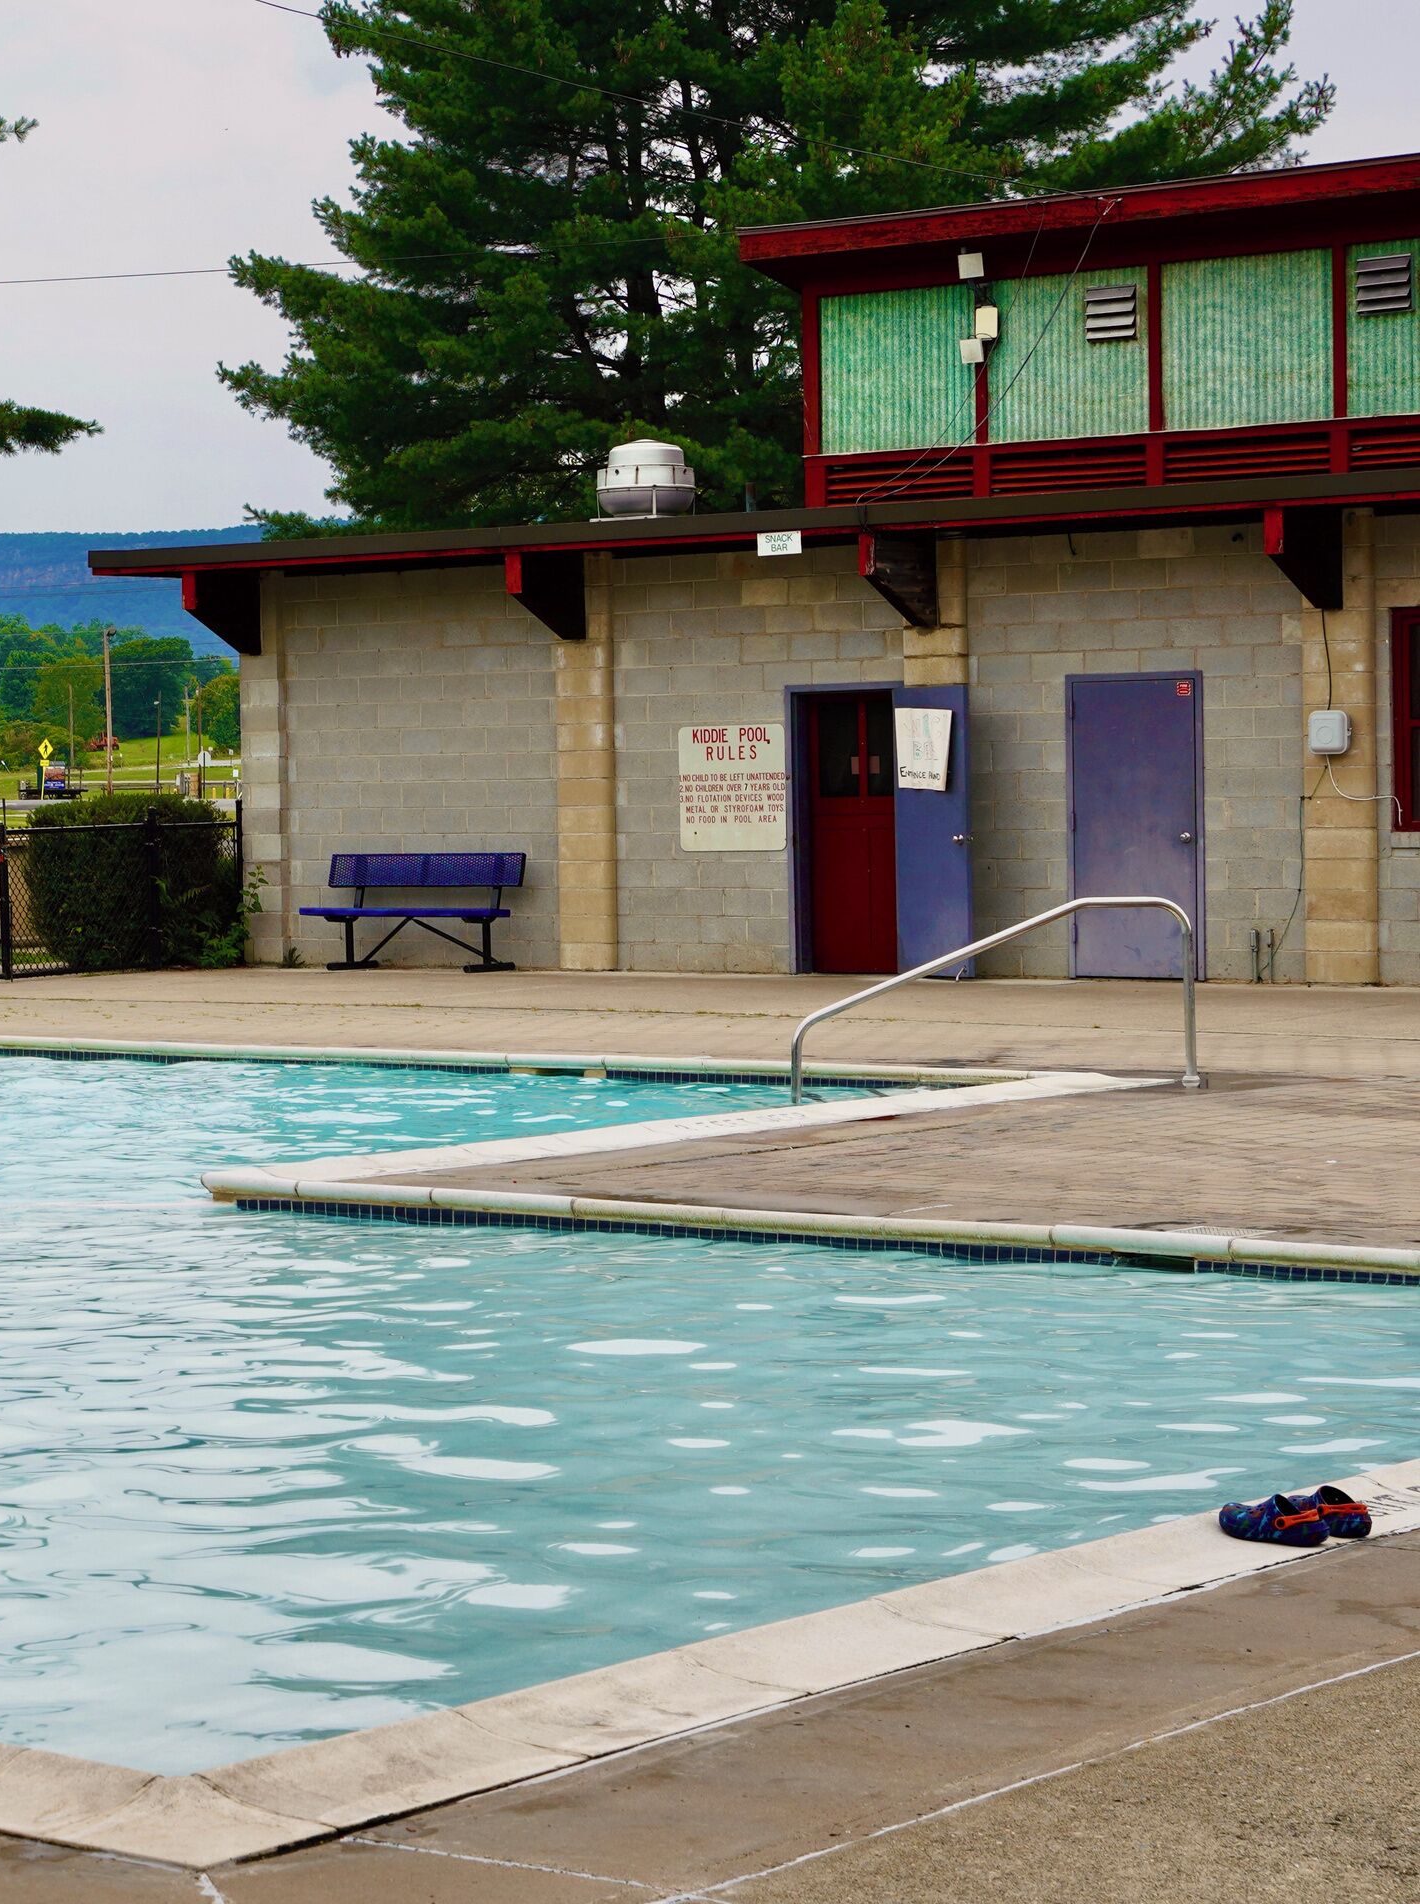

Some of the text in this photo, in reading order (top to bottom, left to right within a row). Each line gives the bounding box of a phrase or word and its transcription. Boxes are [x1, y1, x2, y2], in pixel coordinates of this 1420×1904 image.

[765, 534, 792, 543] SNACK
[771, 543, 788, 552] BAR
[692, 727, 770, 743] KIDDIE POOL
[706, 745, 756, 760] RULES
[747, 772, 785, 780] UNATTENDED
[696, 784, 723, 792] CHILDREN
[744, 783, 748, 791] 7
[750, 783, 770, 791] YEARS
[773, 783, 785, 791] OLD
[735, 794, 762, 802] DEVICES
[724, 805, 764, 813] STYROFOAM
[734, 815, 752, 823] POOL
[759, 815, 777, 823] AREA
